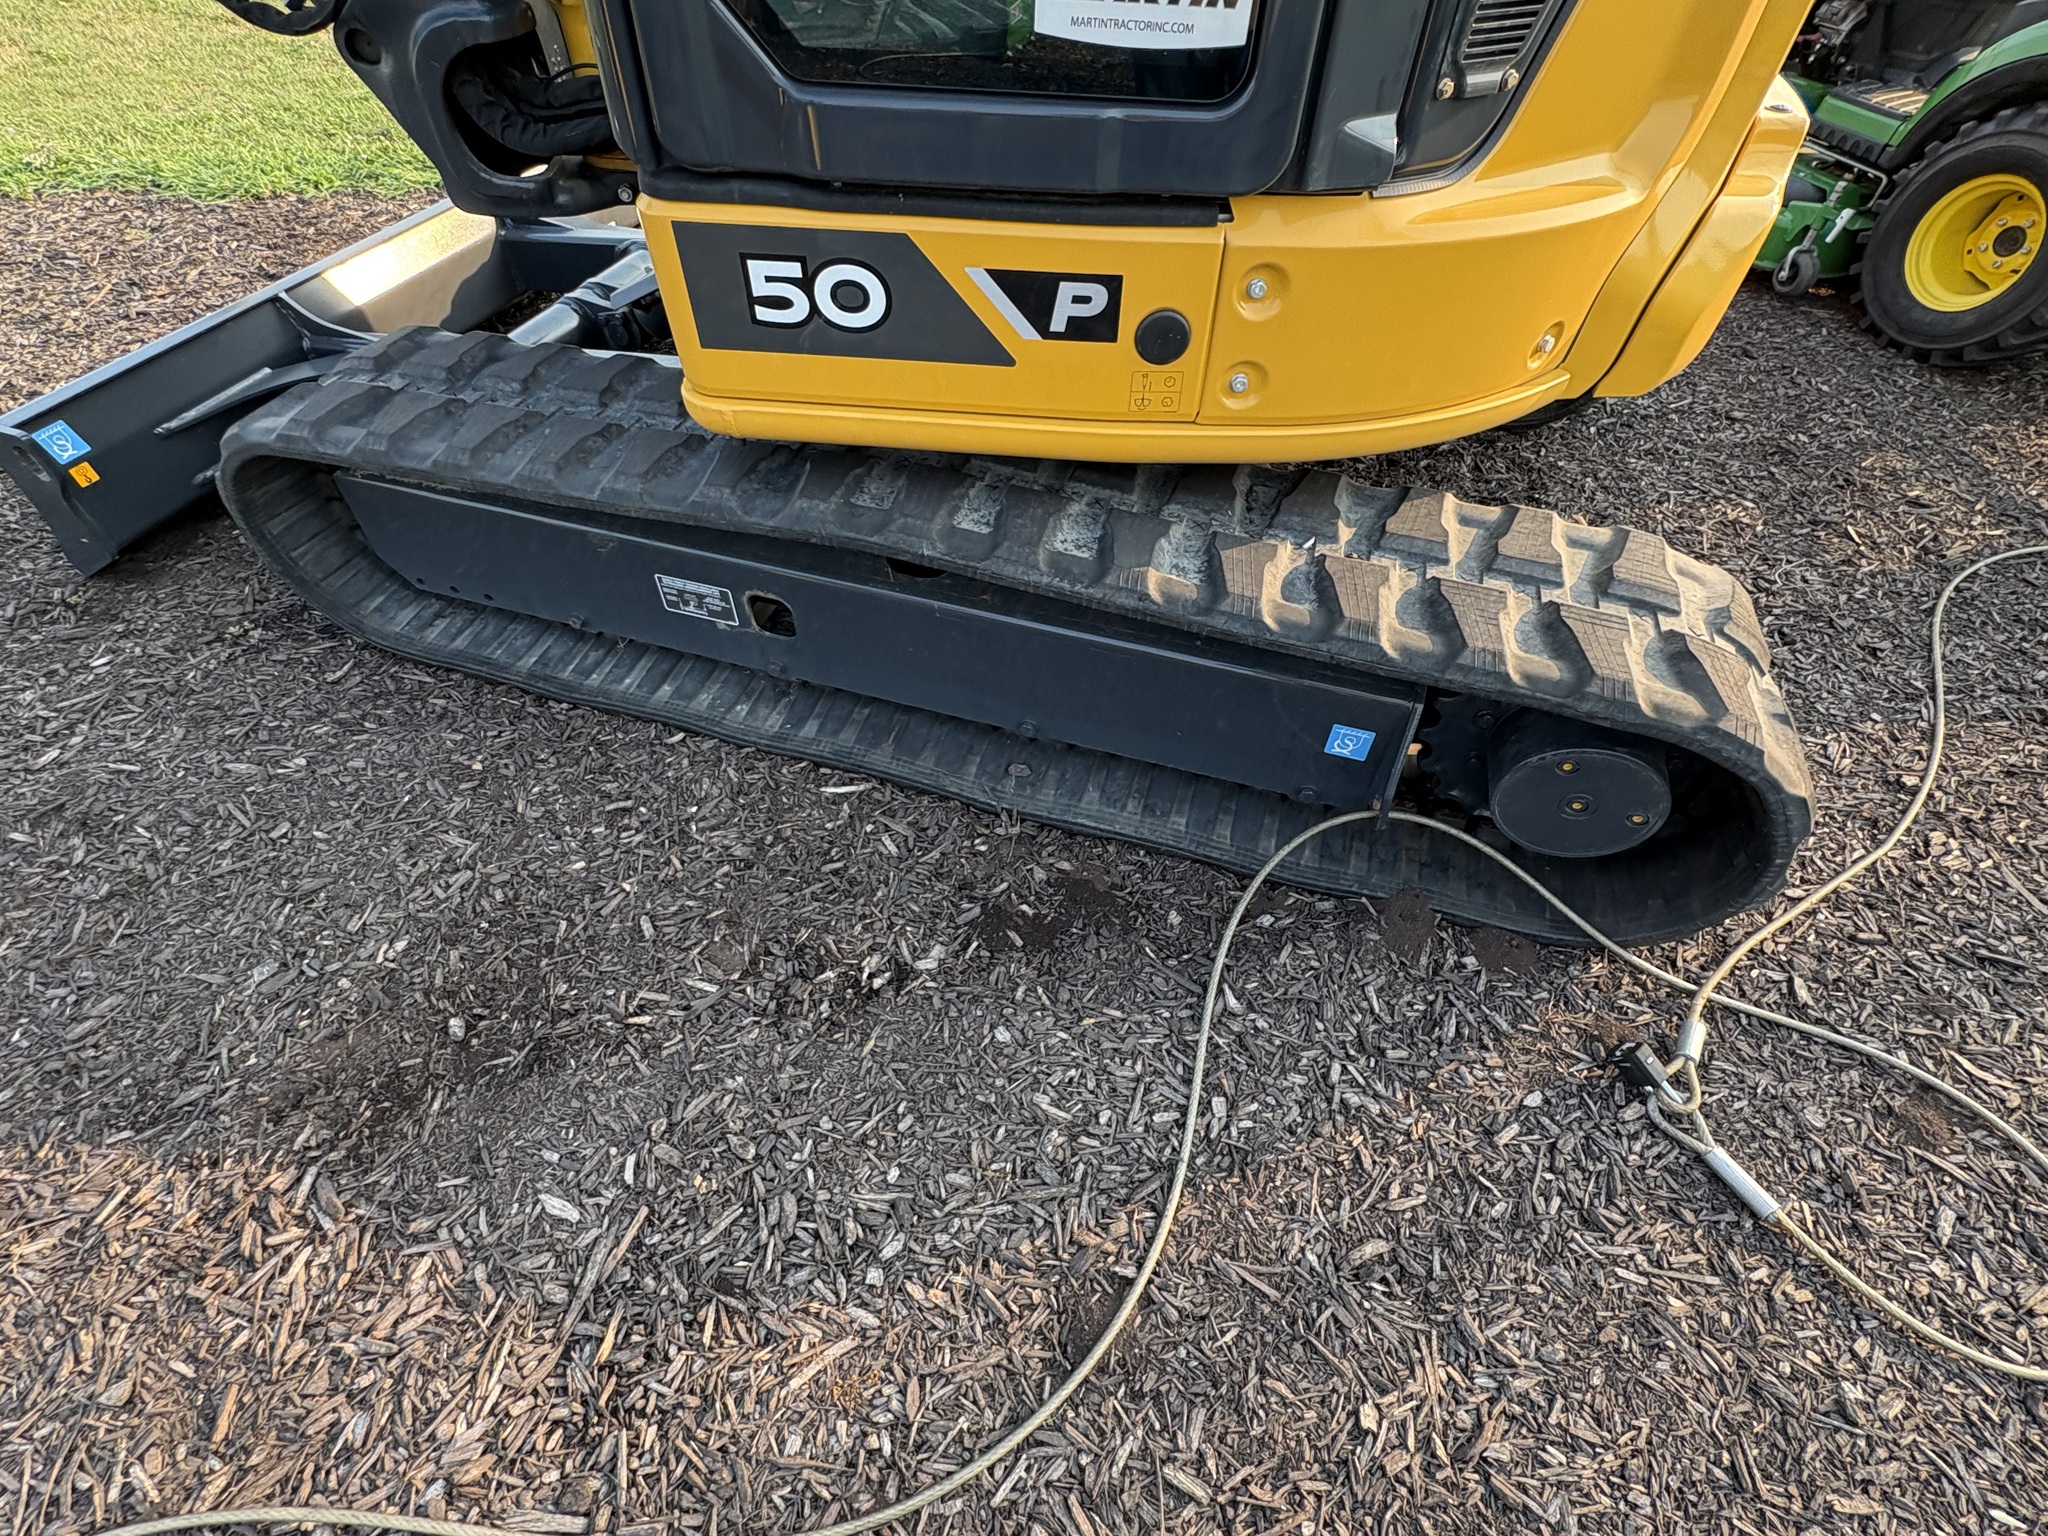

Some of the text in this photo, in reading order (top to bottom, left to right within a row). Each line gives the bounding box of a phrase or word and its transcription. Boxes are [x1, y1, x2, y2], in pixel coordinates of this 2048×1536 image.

[1070, 15, 1195, 35] MARTINTRACTORINC.COM
[744, 257, 889, 331] 50
[1049, 281, 1109, 333] P
